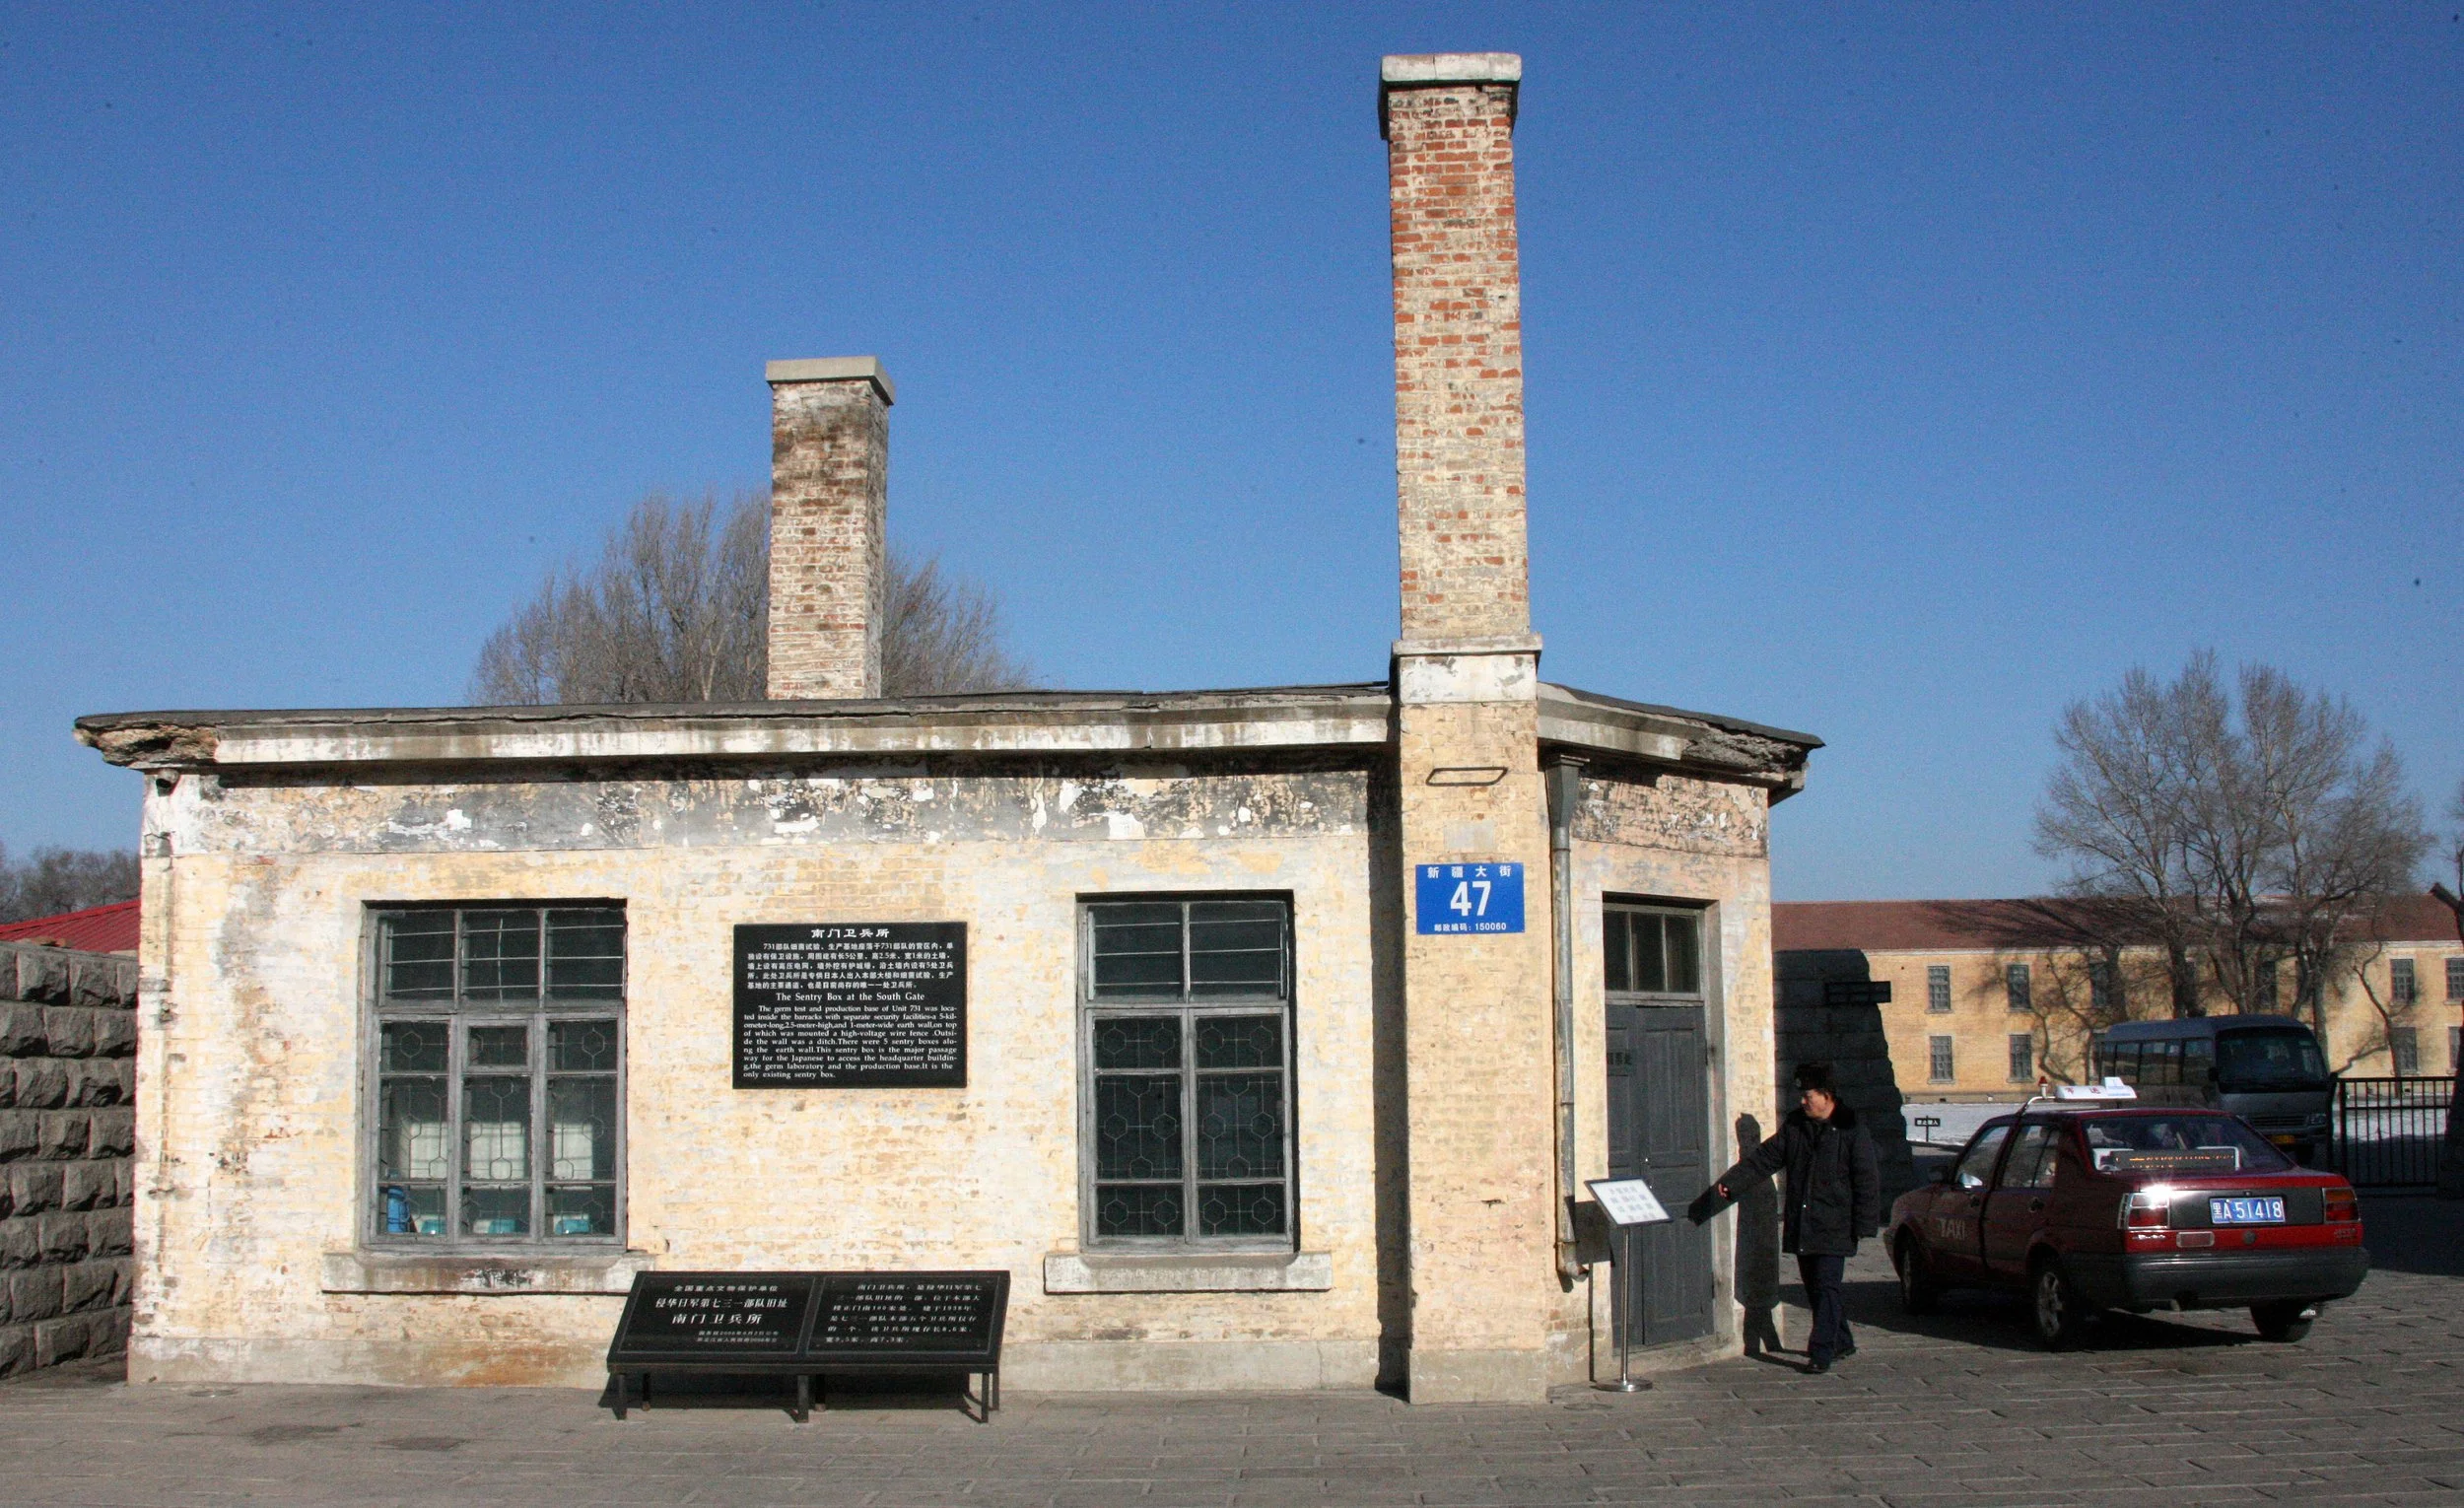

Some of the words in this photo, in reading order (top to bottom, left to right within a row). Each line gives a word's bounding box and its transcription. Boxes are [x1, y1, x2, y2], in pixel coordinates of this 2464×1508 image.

[1427, 865, 1512, 879] 新疆大街
[1450, 880, 1491, 917] 47
[810, 928, 891, 938] 南门卫兵所
[776, 993, 791, 1001] The
[795, 993, 823, 1003] Sentry
[827, 993, 843, 1001] Box
[841, 1030, 886, 1039] high-voltage
[791, 1055, 824, 1063] Japanese
[1939, 1218, 1966, 1240] TAXI
[655, 1298, 787, 1308] 侵华日军第七三一部队旧址
[671, 1314, 763, 1325] 南门卫兵所
